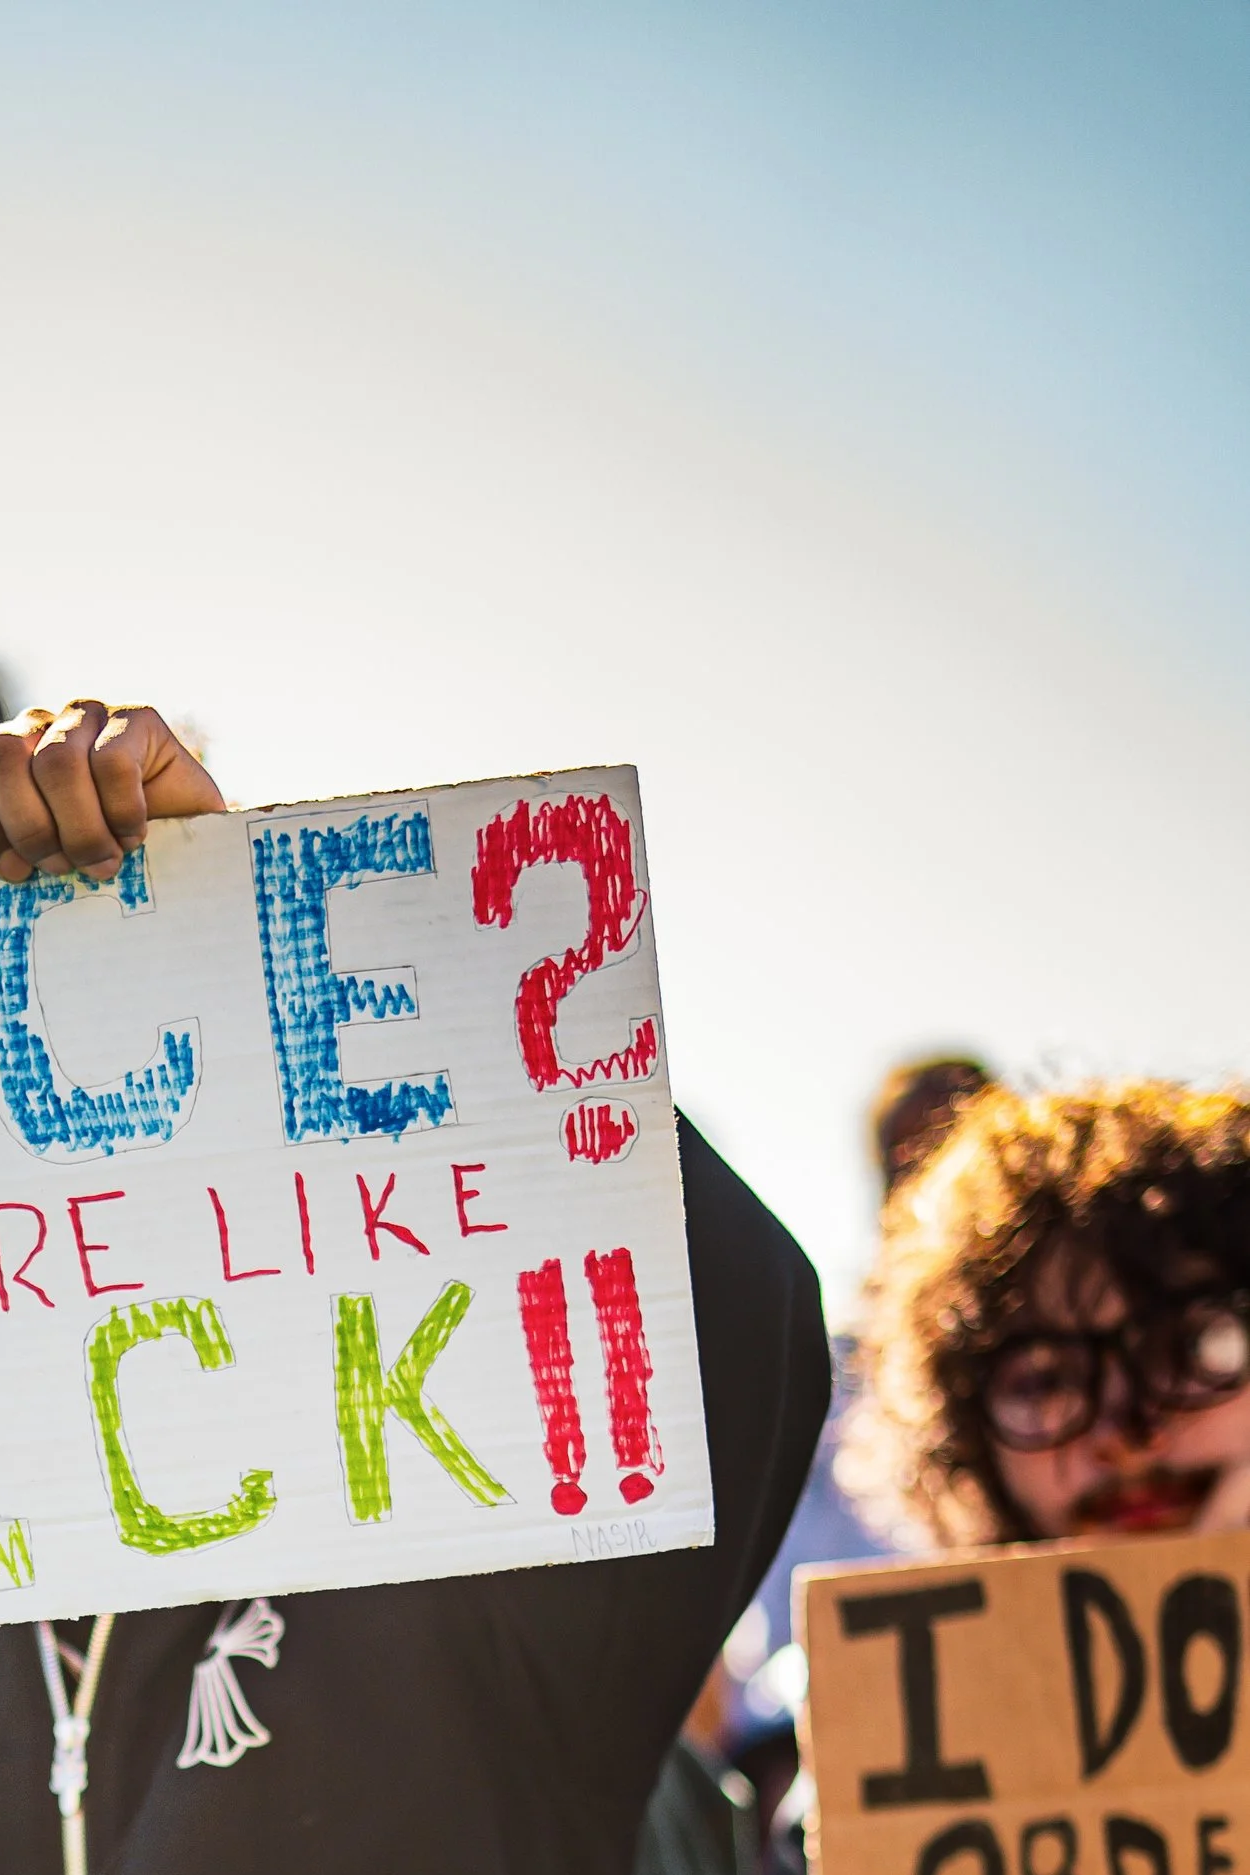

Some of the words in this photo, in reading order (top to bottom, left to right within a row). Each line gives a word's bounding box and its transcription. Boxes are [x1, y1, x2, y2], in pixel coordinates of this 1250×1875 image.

[207, 1162, 510, 1283] LIKE
[570, 1518, 658, 1557] NASIR
[837, 1575, 993, 1811] I
